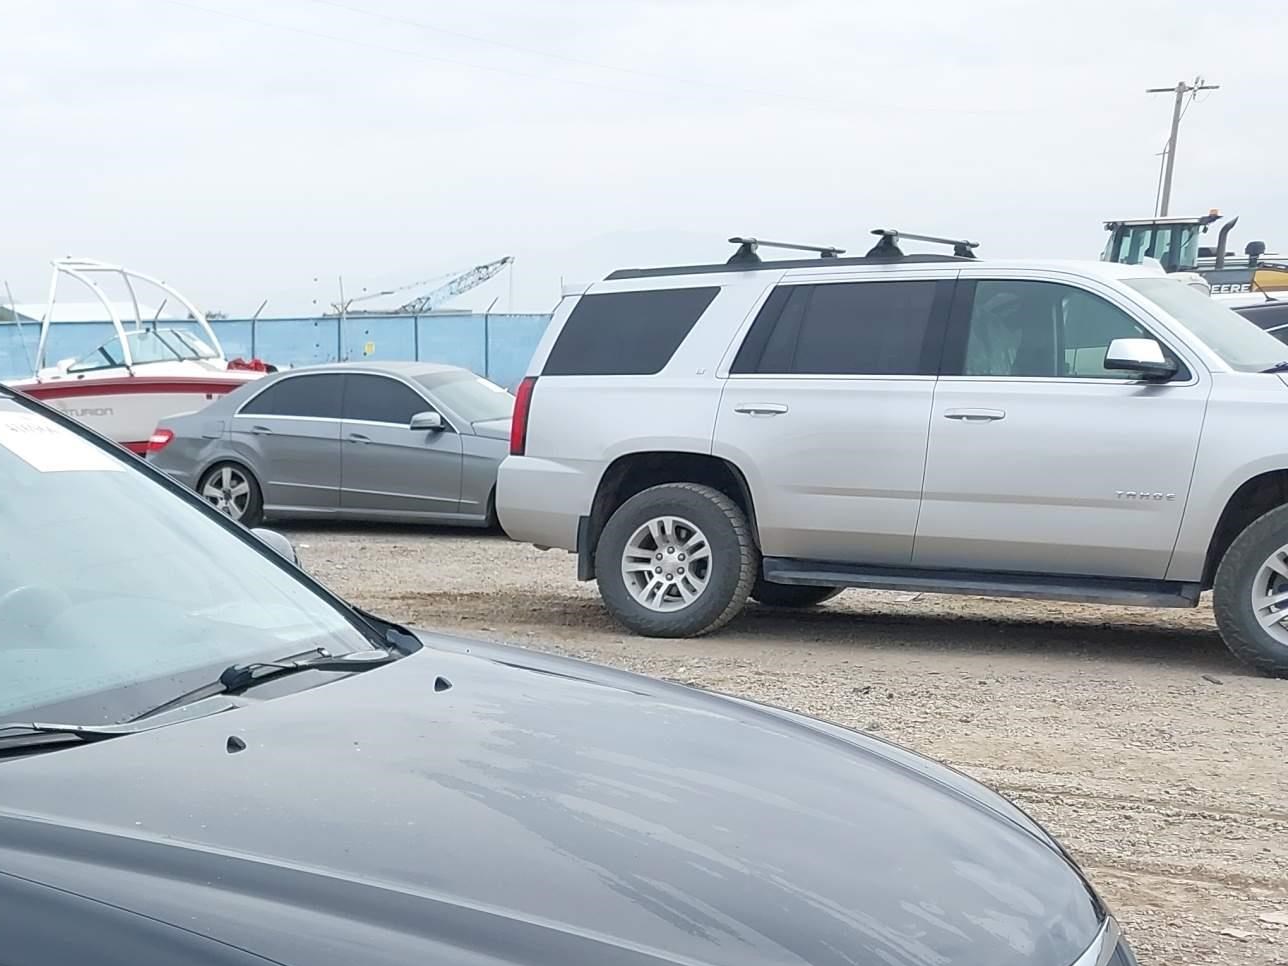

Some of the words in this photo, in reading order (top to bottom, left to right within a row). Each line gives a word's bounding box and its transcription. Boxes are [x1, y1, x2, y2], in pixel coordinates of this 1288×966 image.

[1208, 283, 1251, 294] EERE
[62, 406, 116, 418] TURION
[1114, 489, 1177, 502] TAHOE
